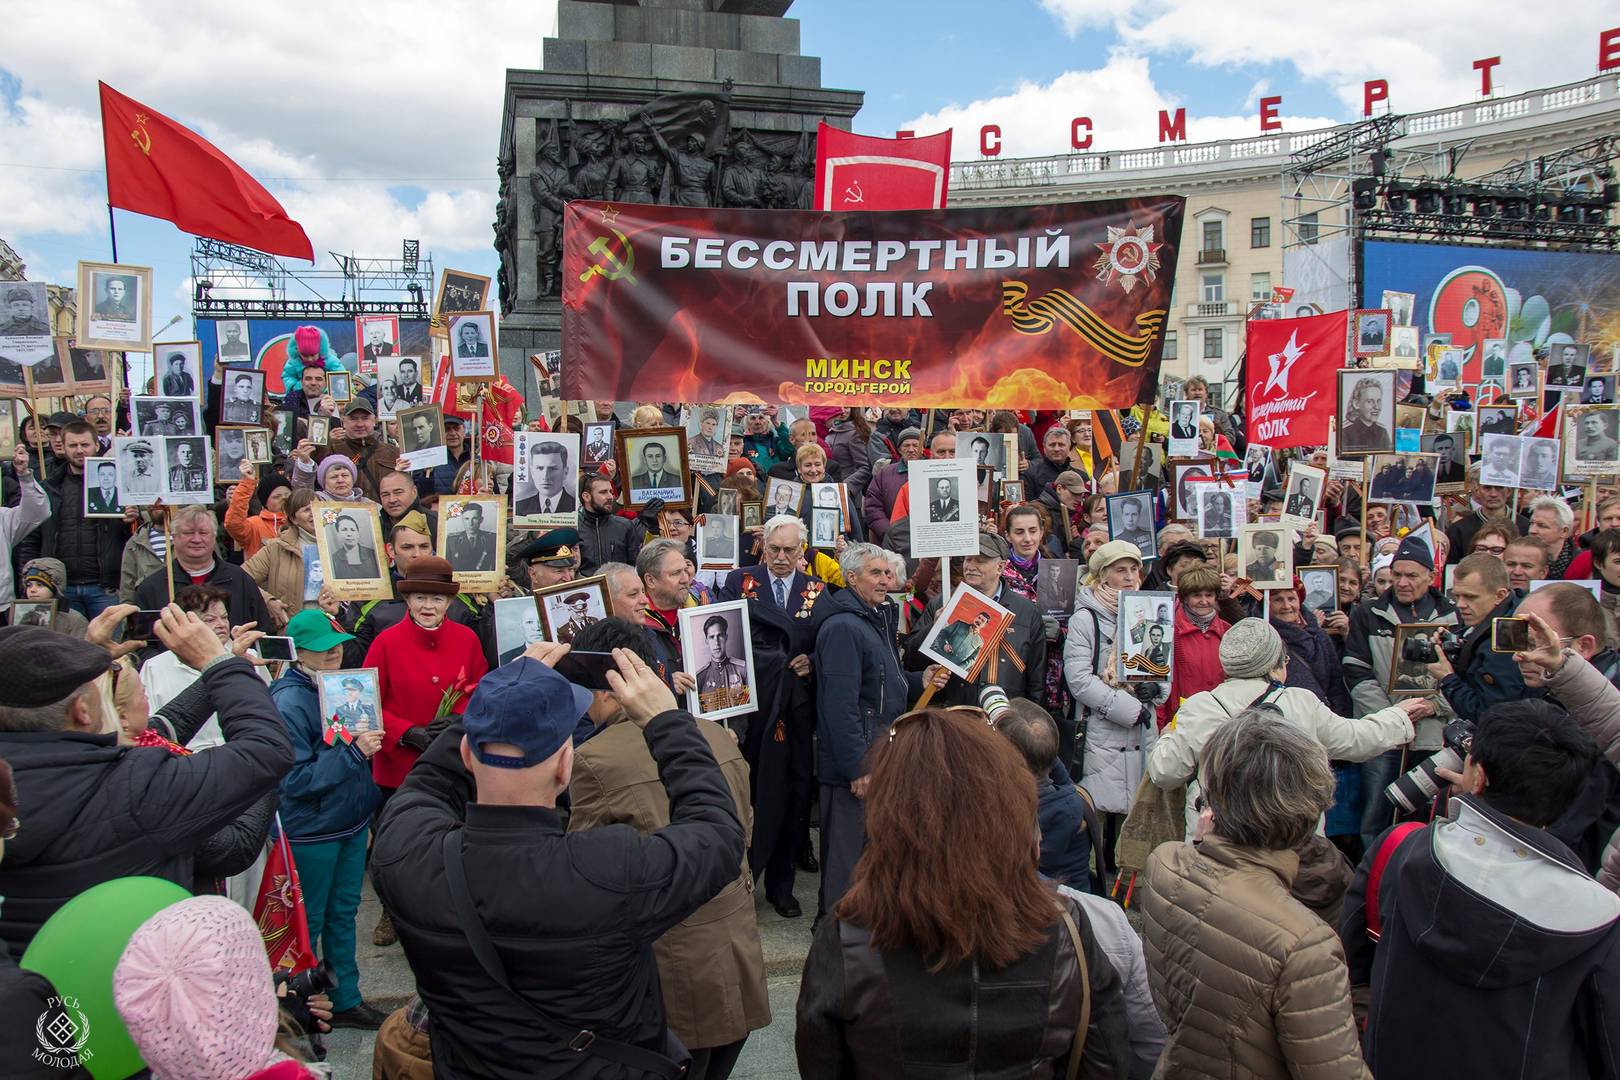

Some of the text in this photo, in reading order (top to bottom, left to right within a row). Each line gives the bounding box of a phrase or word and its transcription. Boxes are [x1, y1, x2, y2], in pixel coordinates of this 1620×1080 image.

[660, 229, 1070, 271] БЕССМЕРТНЫЙ
[787, 281, 933, 317] ПОЛК
[806, 358, 912, 379] МИНСК
[805, 380, 911, 395] ГОРОД-ГЕРОЙ
[1258, 417, 1290, 441] ПОЛК
